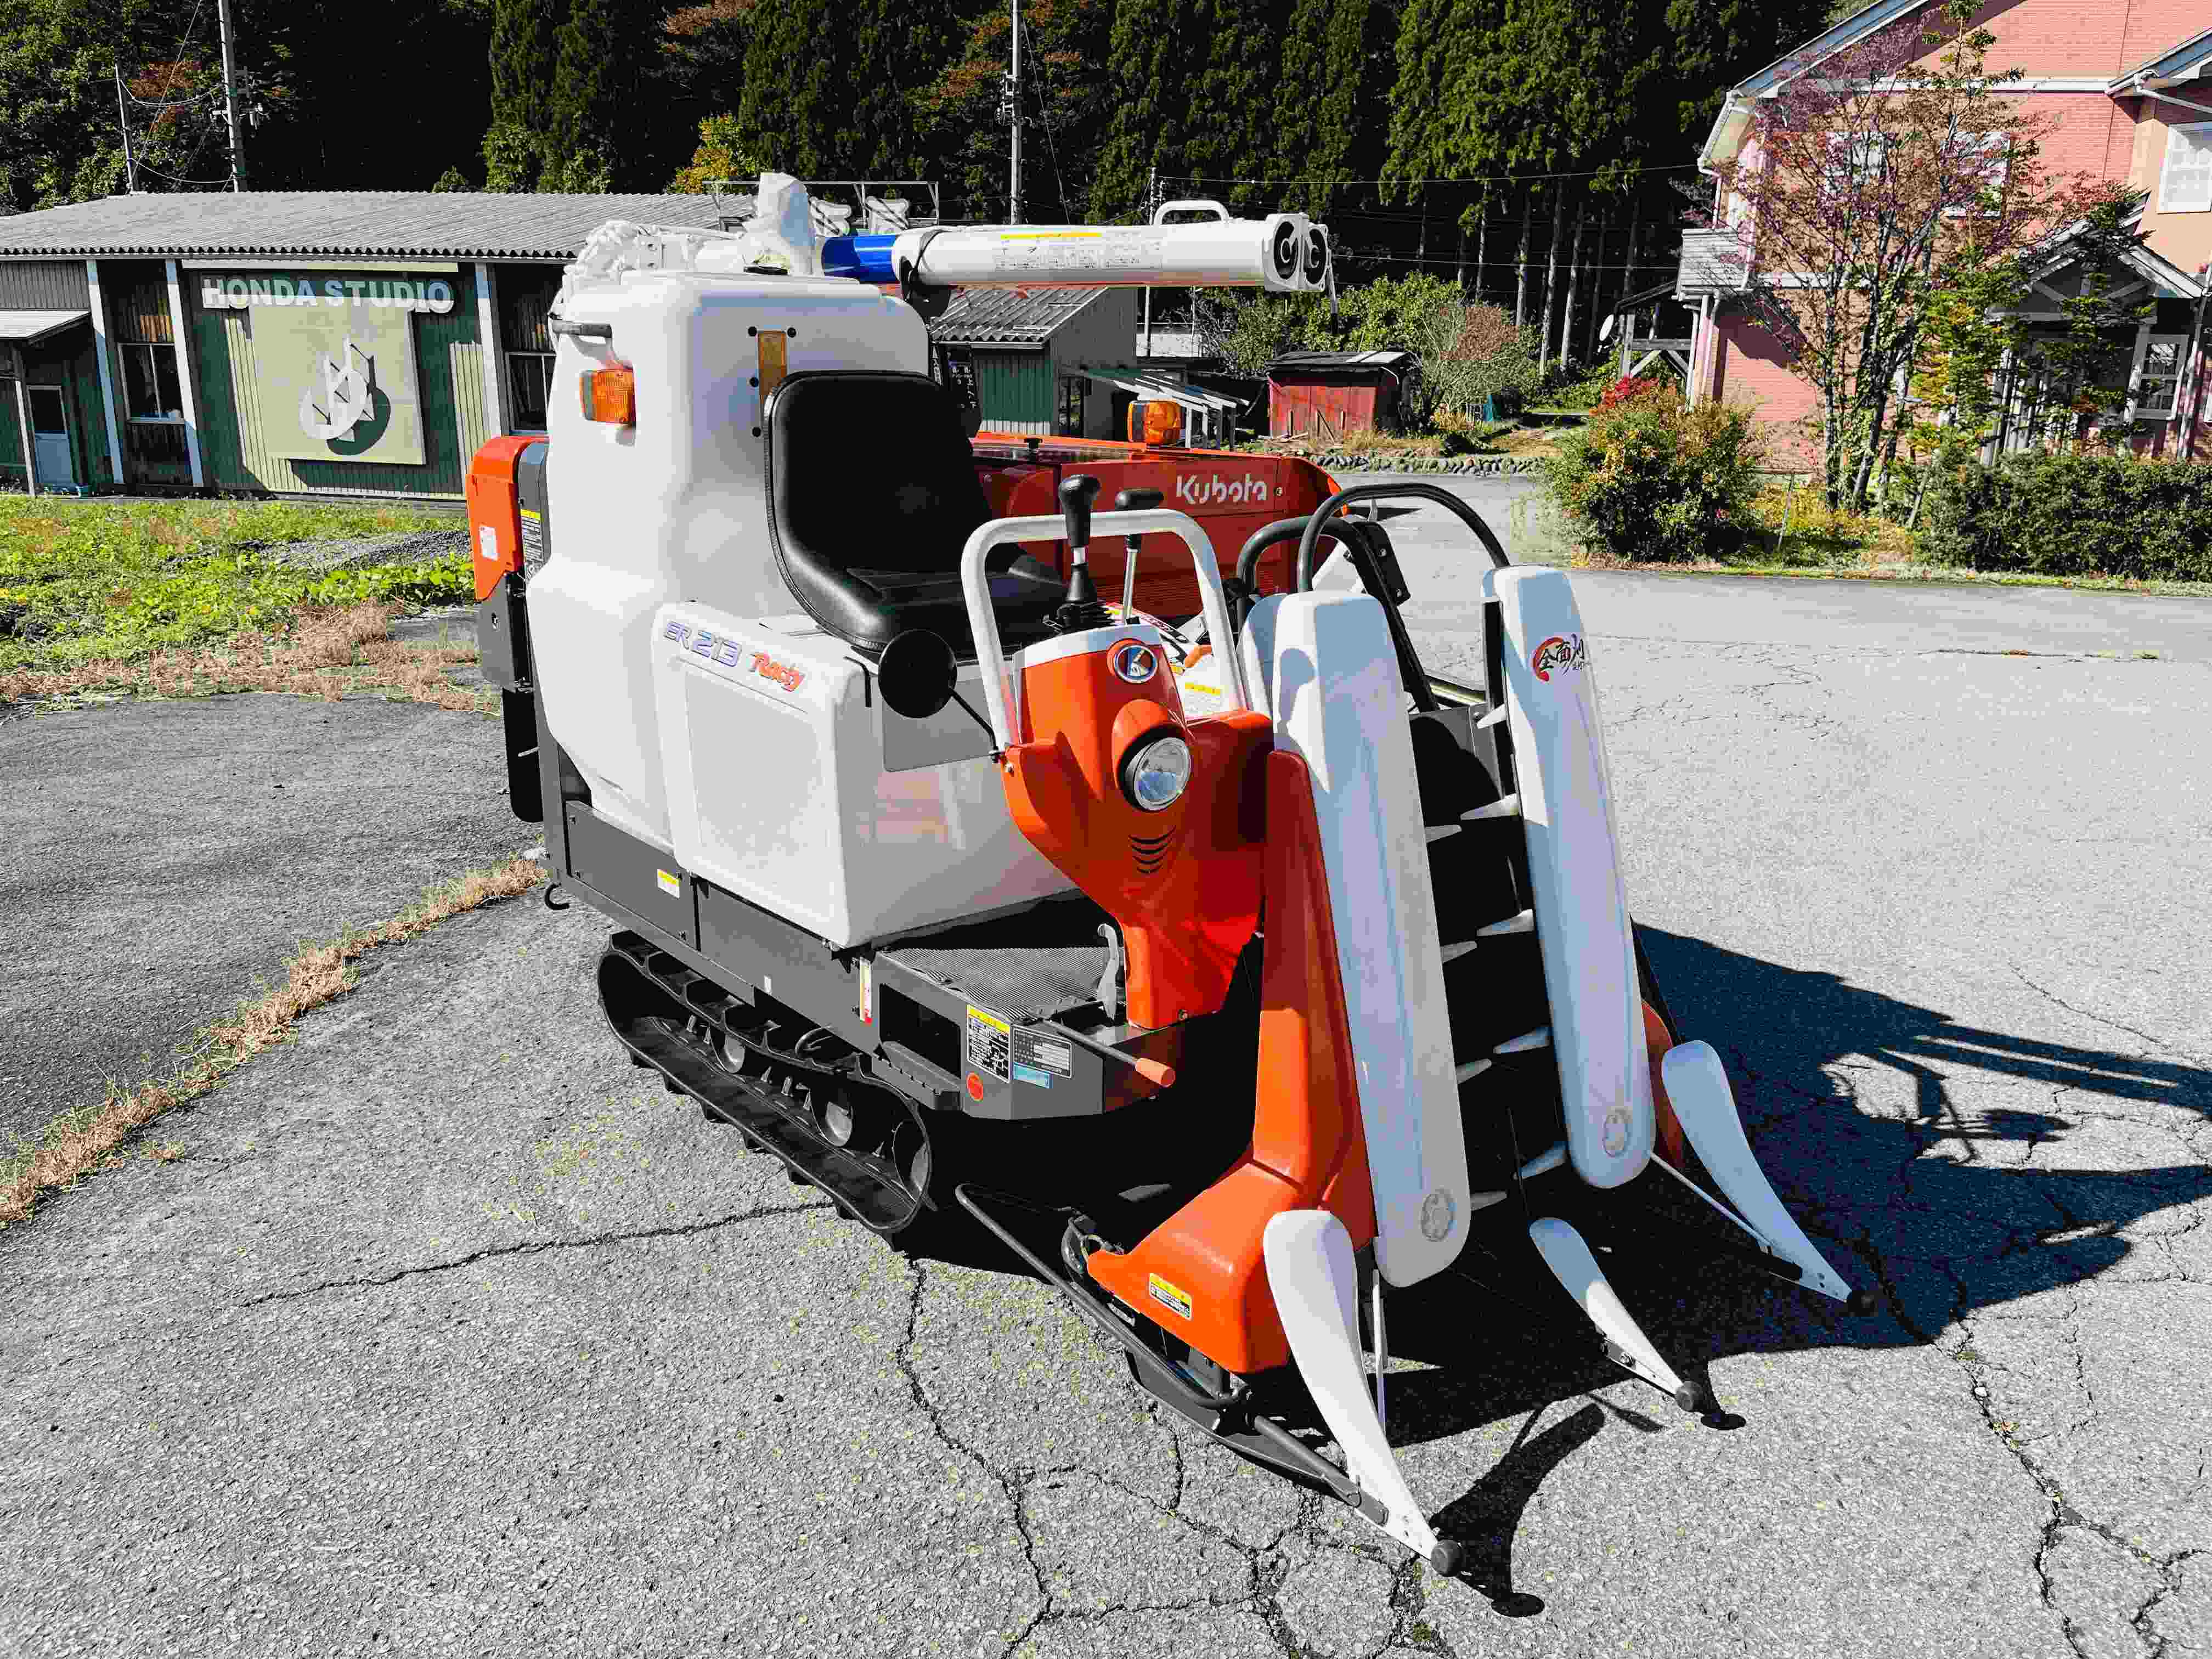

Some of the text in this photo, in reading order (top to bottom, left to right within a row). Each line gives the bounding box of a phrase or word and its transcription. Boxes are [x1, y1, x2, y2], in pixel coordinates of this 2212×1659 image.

[202, 277, 454, 313] HONDA STUDIO
[1176, 473, 1267, 504] Kubota
